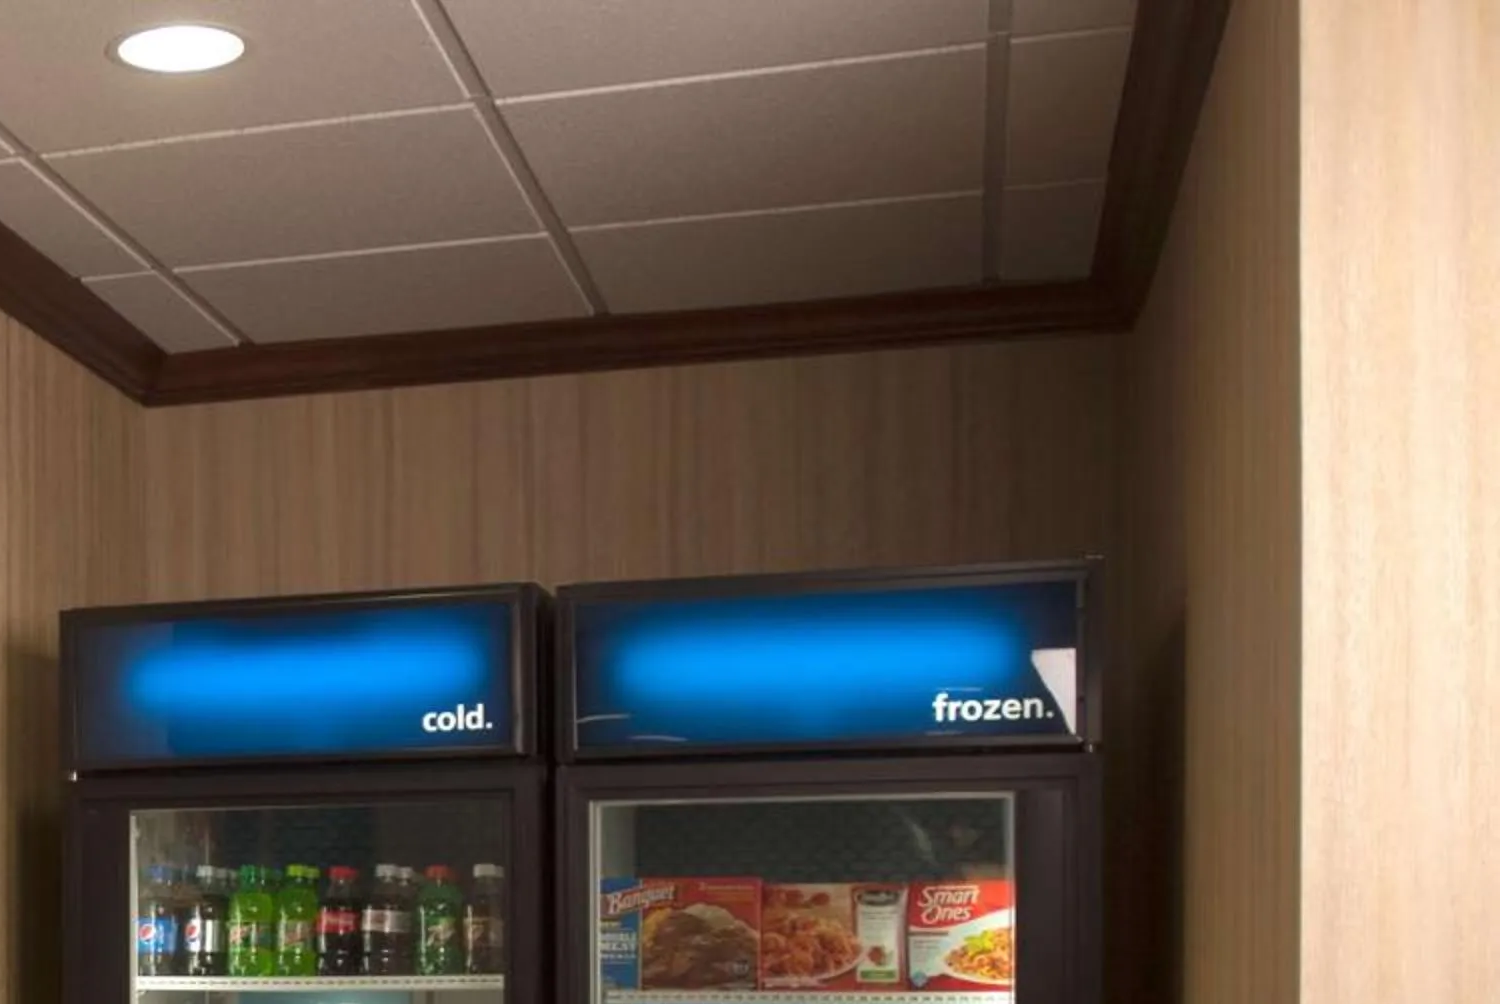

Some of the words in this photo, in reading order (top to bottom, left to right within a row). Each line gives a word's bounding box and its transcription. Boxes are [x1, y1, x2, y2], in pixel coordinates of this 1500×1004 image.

[422, 703, 493, 732] cold.
[931, 691, 1055, 722] frozen.
[918, 885, 980, 907] Smart
[920, 906, 973, 925] Ones
